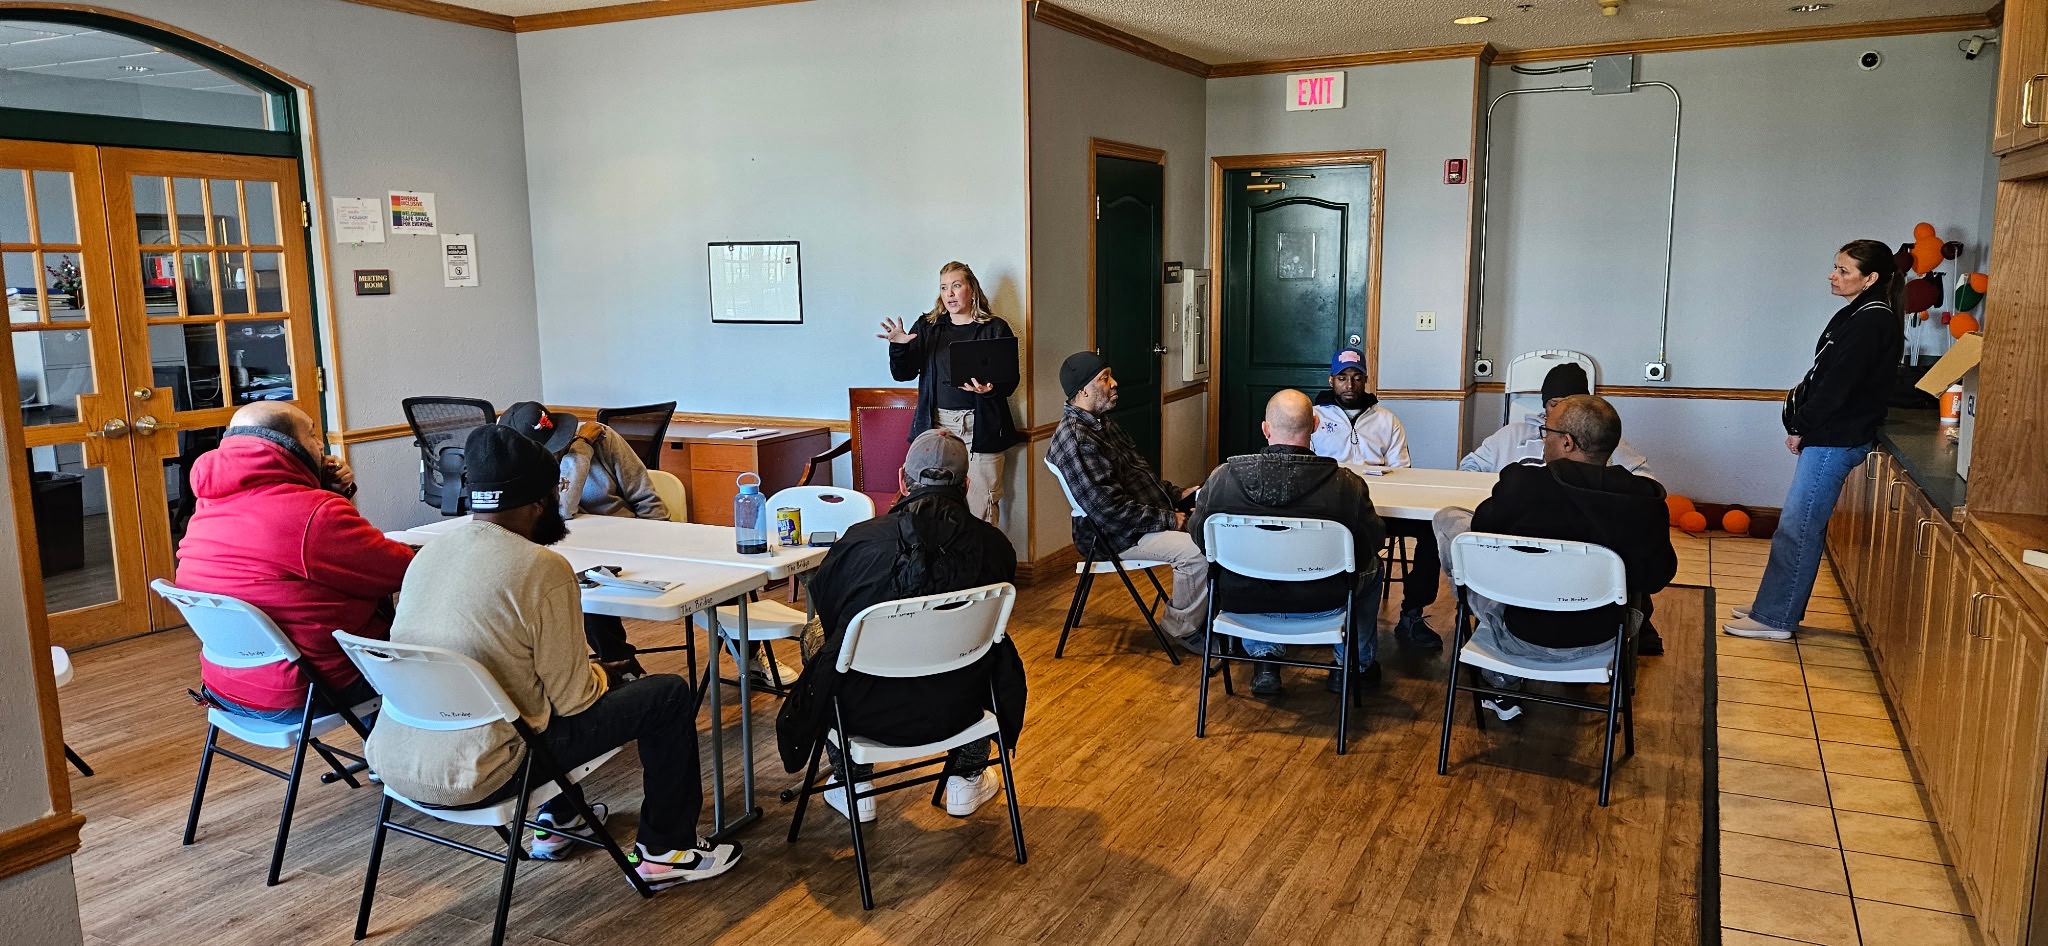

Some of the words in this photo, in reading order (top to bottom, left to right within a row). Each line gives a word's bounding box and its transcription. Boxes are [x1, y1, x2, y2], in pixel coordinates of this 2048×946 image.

[1298, 77, 1335, 106] EXIT
[472, 491, 503, 500] BEST
[787, 564, 797, 573] The
[797, 560, 811, 570] Bridge
[681, 604, 693, 615] The
[694, 597, 714, 609] Bridge
